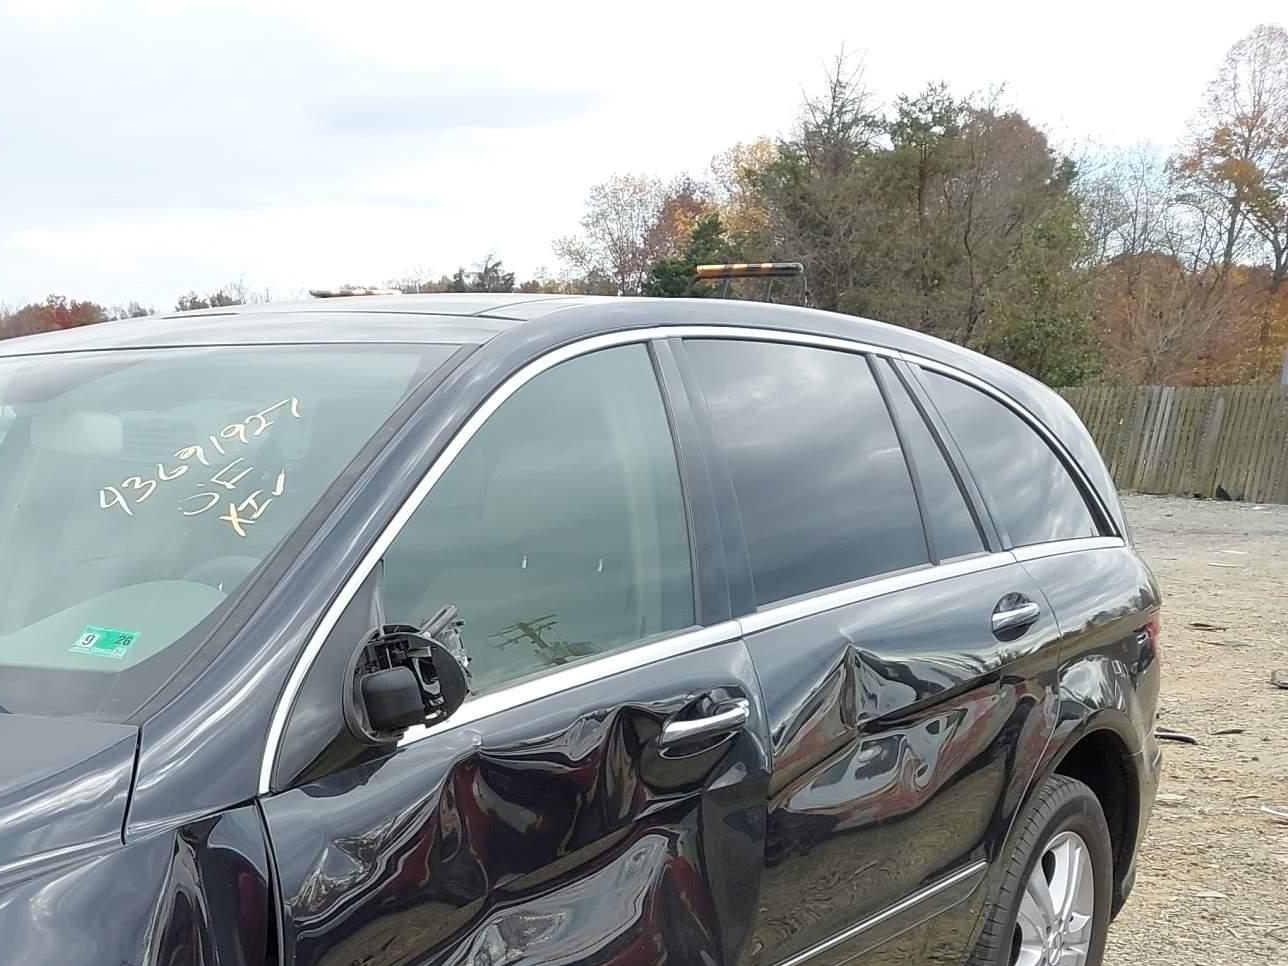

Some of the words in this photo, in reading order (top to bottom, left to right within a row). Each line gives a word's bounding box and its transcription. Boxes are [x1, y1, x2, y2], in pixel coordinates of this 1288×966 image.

[98, 397, 303, 516] 43691927
[82, 634, 96, 646] 9
[114, 635, 134, 646] 26
